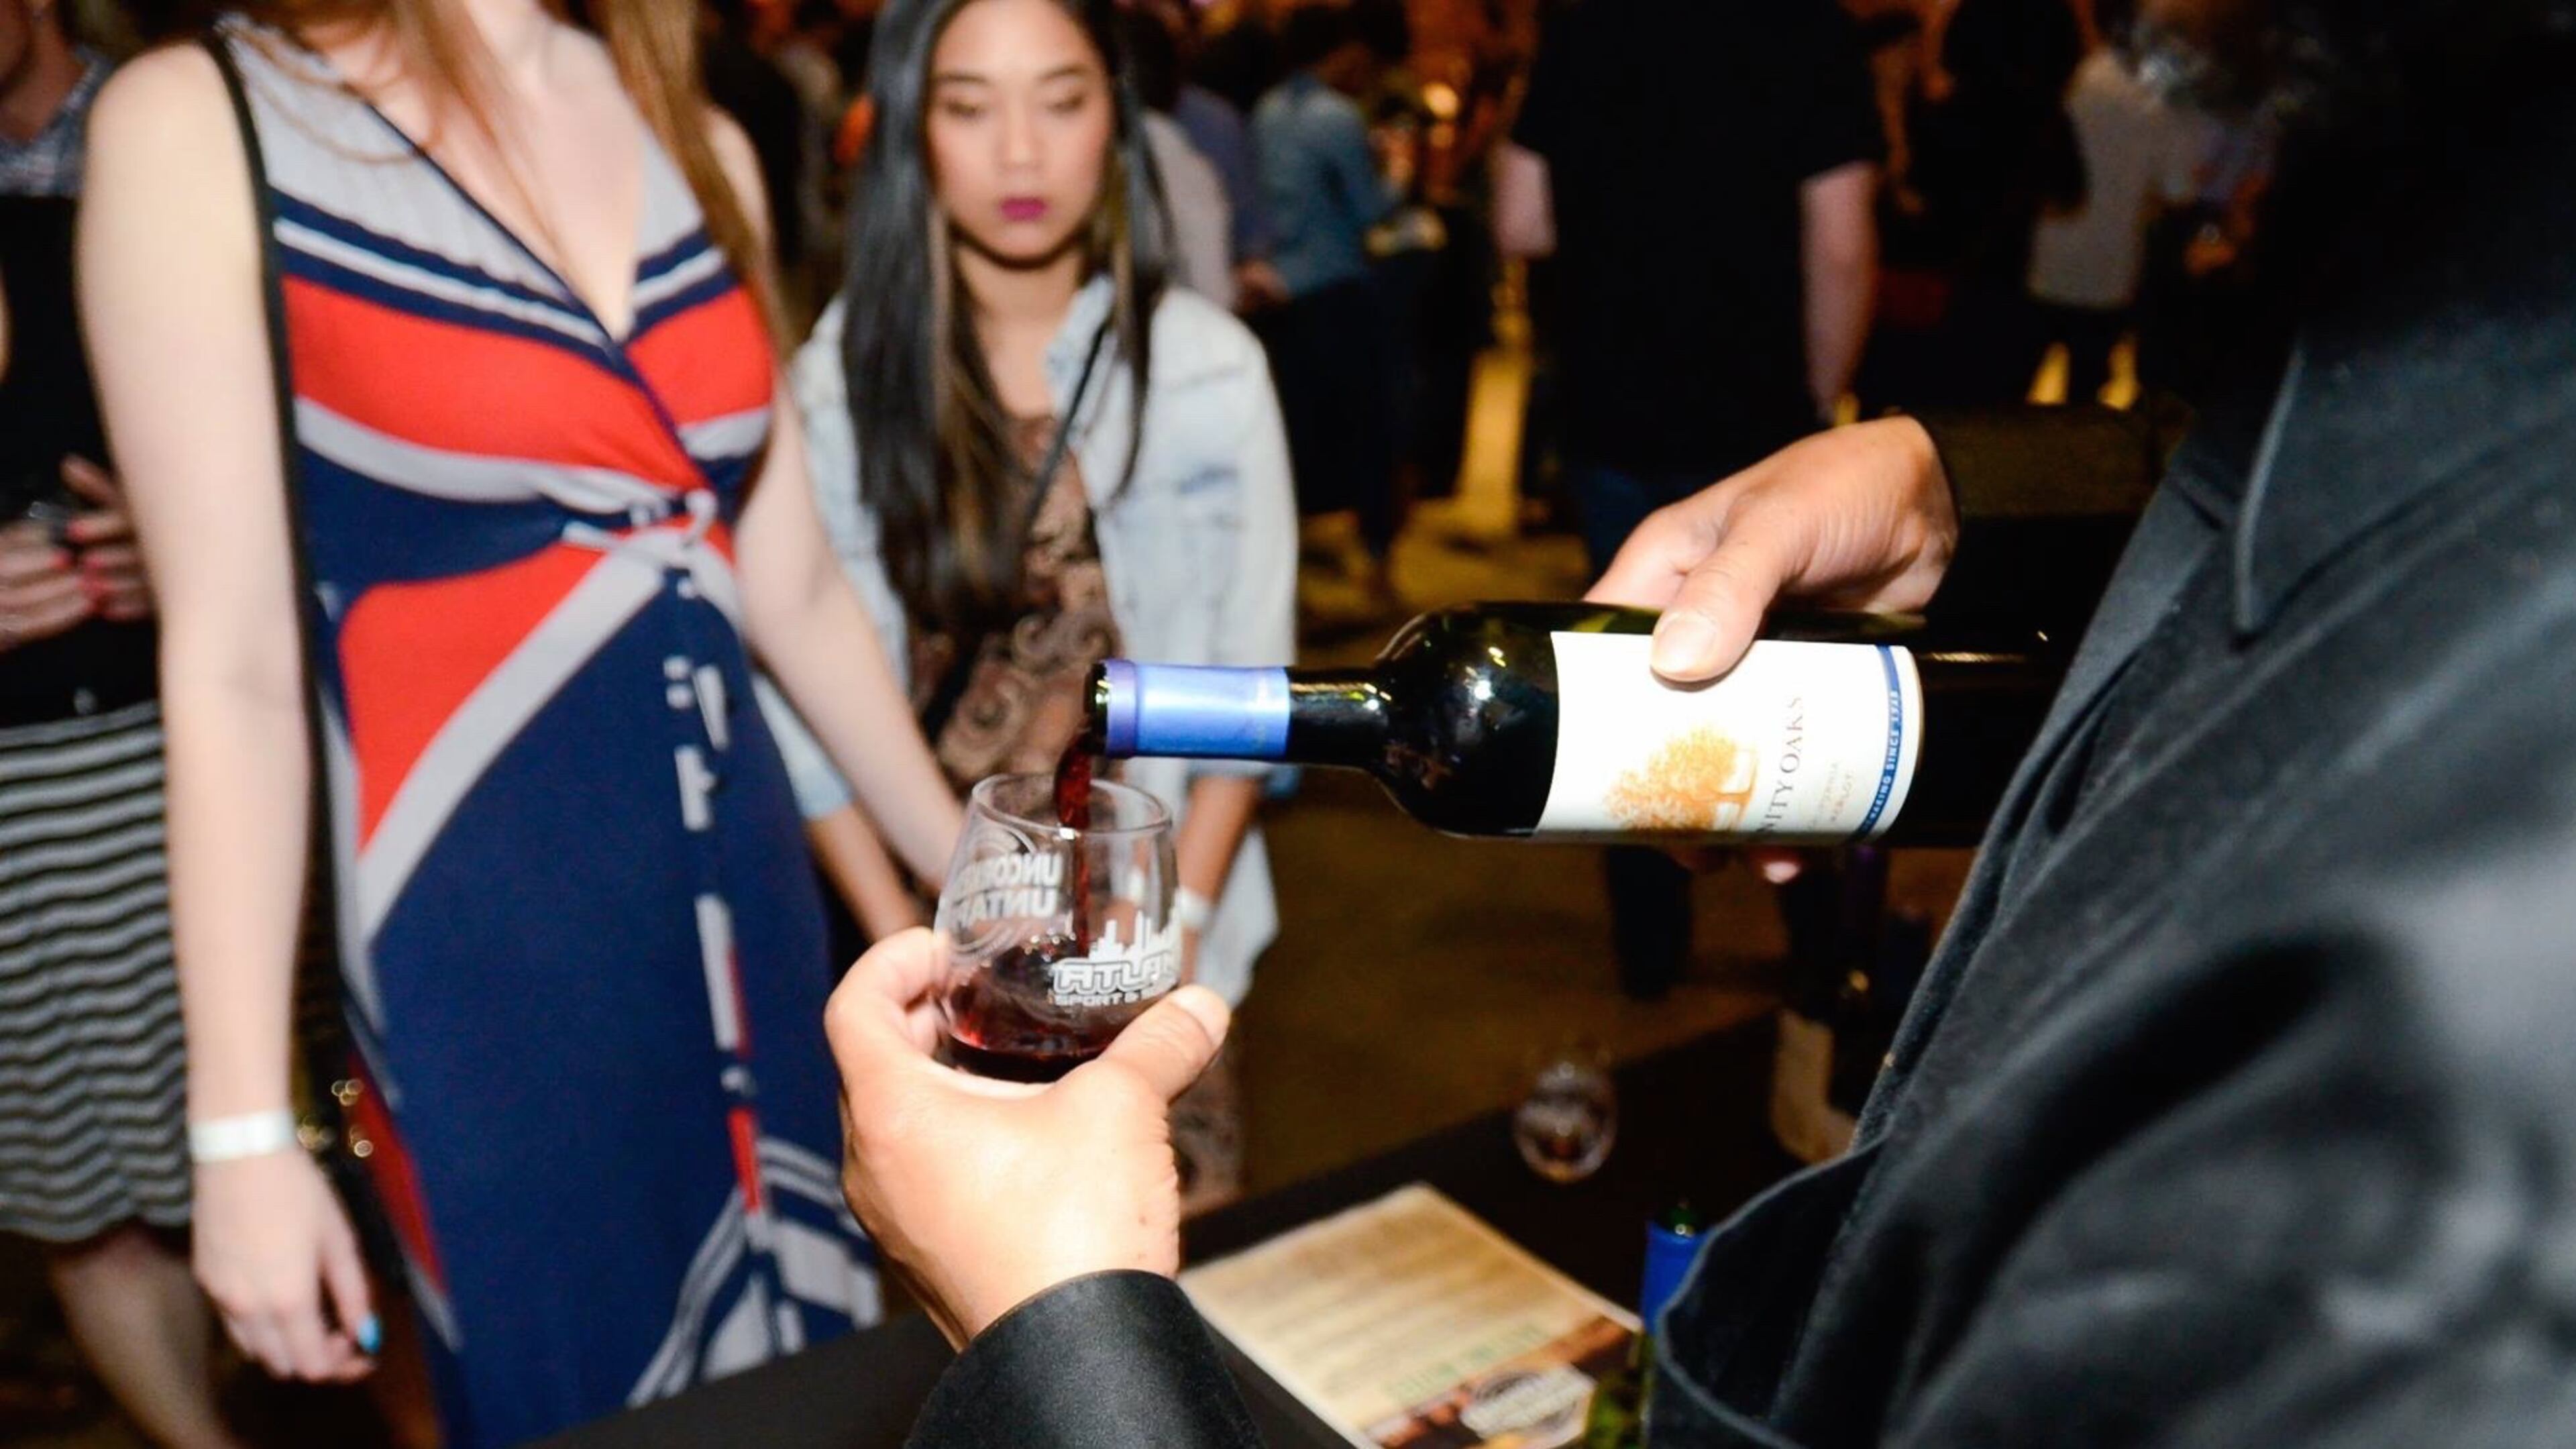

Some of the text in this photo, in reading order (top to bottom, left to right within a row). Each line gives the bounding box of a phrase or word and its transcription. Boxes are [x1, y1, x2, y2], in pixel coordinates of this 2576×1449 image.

[1780, 696, 1803, 773] OAKS
[1862, 775, 1892, 832] MAKING
[1886, 729, 1900, 771] SINCE
[1055, 991, 1124, 1007] SPORT
